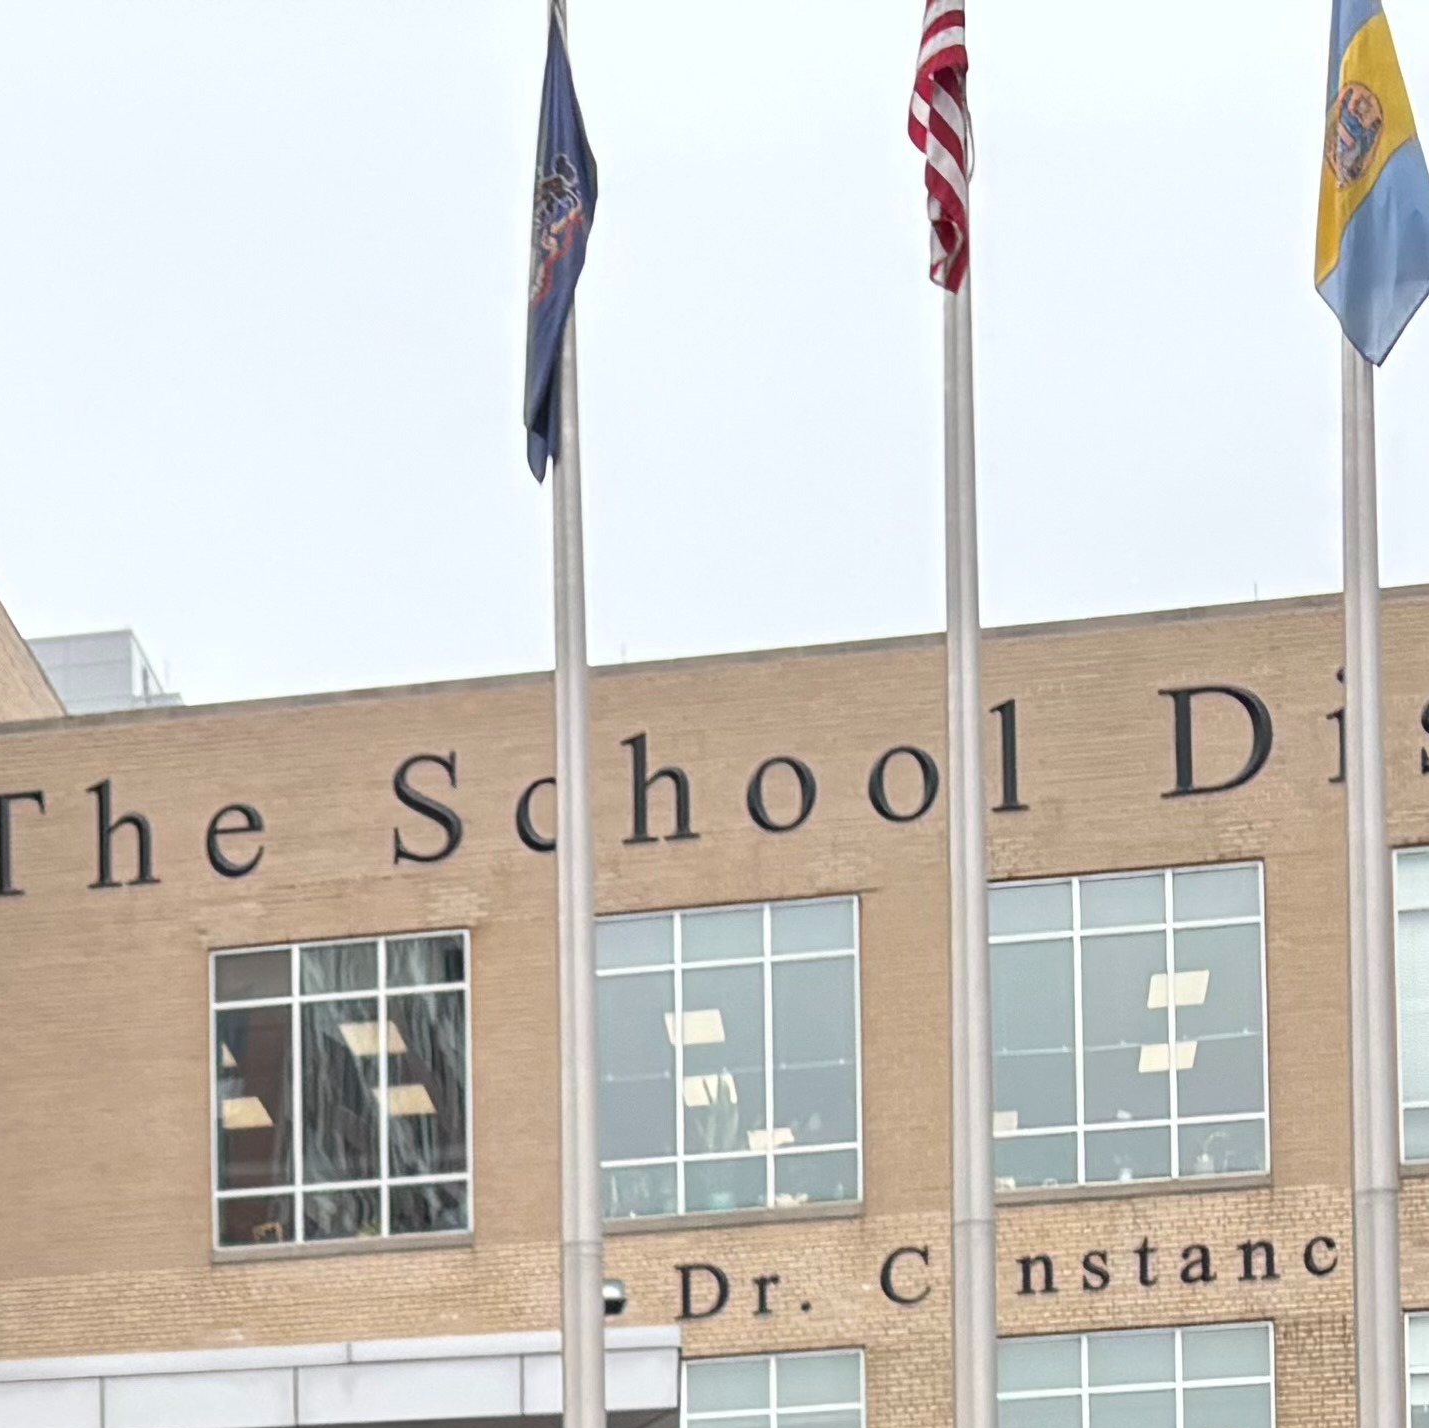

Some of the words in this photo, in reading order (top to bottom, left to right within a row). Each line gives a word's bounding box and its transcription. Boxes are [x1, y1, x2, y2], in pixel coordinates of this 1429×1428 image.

[391, 698, 1030, 866] School
[1157, 666, 1429, 799] Di
[674, 1262, 813, 1321] Dr.
[878, 1232, 1340, 1305] Cnstanc
